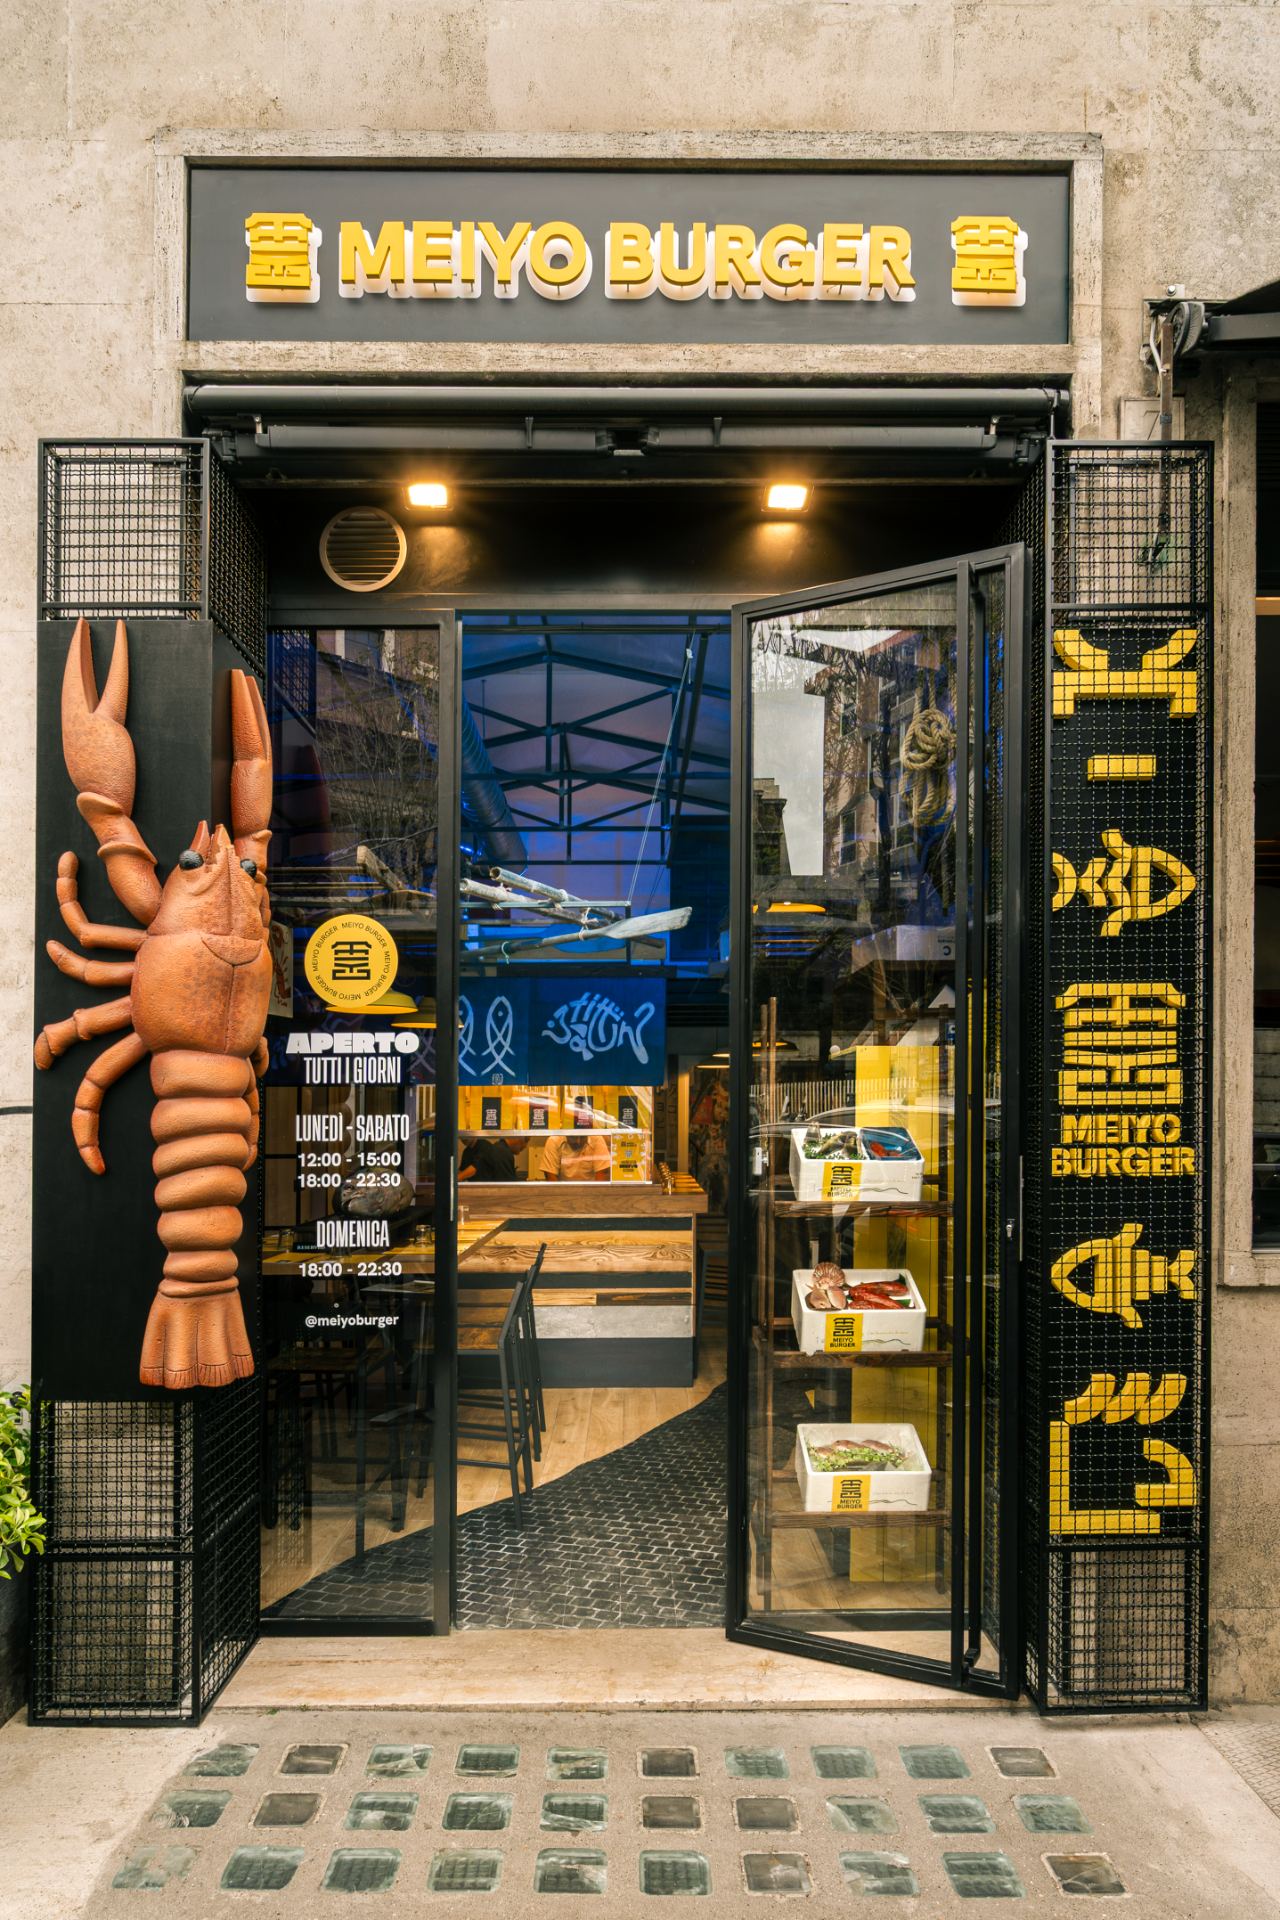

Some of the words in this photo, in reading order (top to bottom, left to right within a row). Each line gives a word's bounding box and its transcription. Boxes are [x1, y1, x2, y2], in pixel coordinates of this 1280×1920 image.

[339, 221, 588, 290] MEIYO
[607, 221, 916, 291] BURGER
[342, 921, 364, 929] MEIYO
[365, 925, 387, 948] BURGER
[311, 949, 320, 973] MEIYO
[316, 925, 338, 948] BURGER
[315, 974, 338, 997] BURGER
[339, 992, 361, 1001] MEIYO
[365, 975, 387, 997] BURGER
[285, 1031, 420, 1055] APERTO
[303, 1056, 341, 1084] TUTTI
[345, 1056, 350, 1084] I
[353, 1056, 401, 1084] GIORNI
[295, 1112, 343, 1142] LUNEDÌ
[356, 1114, 410, 1142] SABATO
[1061, 1113, 1182, 1144] MEIYO
[298, 1152, 342, 1167] 12:00
[357, 1152, 402, 1167] 15:00
[1051, 1147, 1197, 1178] BURGER
[298, 1173, 342, 1188] 18:00
[356, 1172, 401, 1187] 22:30
[316, 1220, 390, 1248] DOMENICA
[299, 1262, 343, 1278] 18:00
[357, 1261, 402, 1277] 22:30
[304, 1314, 400, 1329] @meiyoburger
